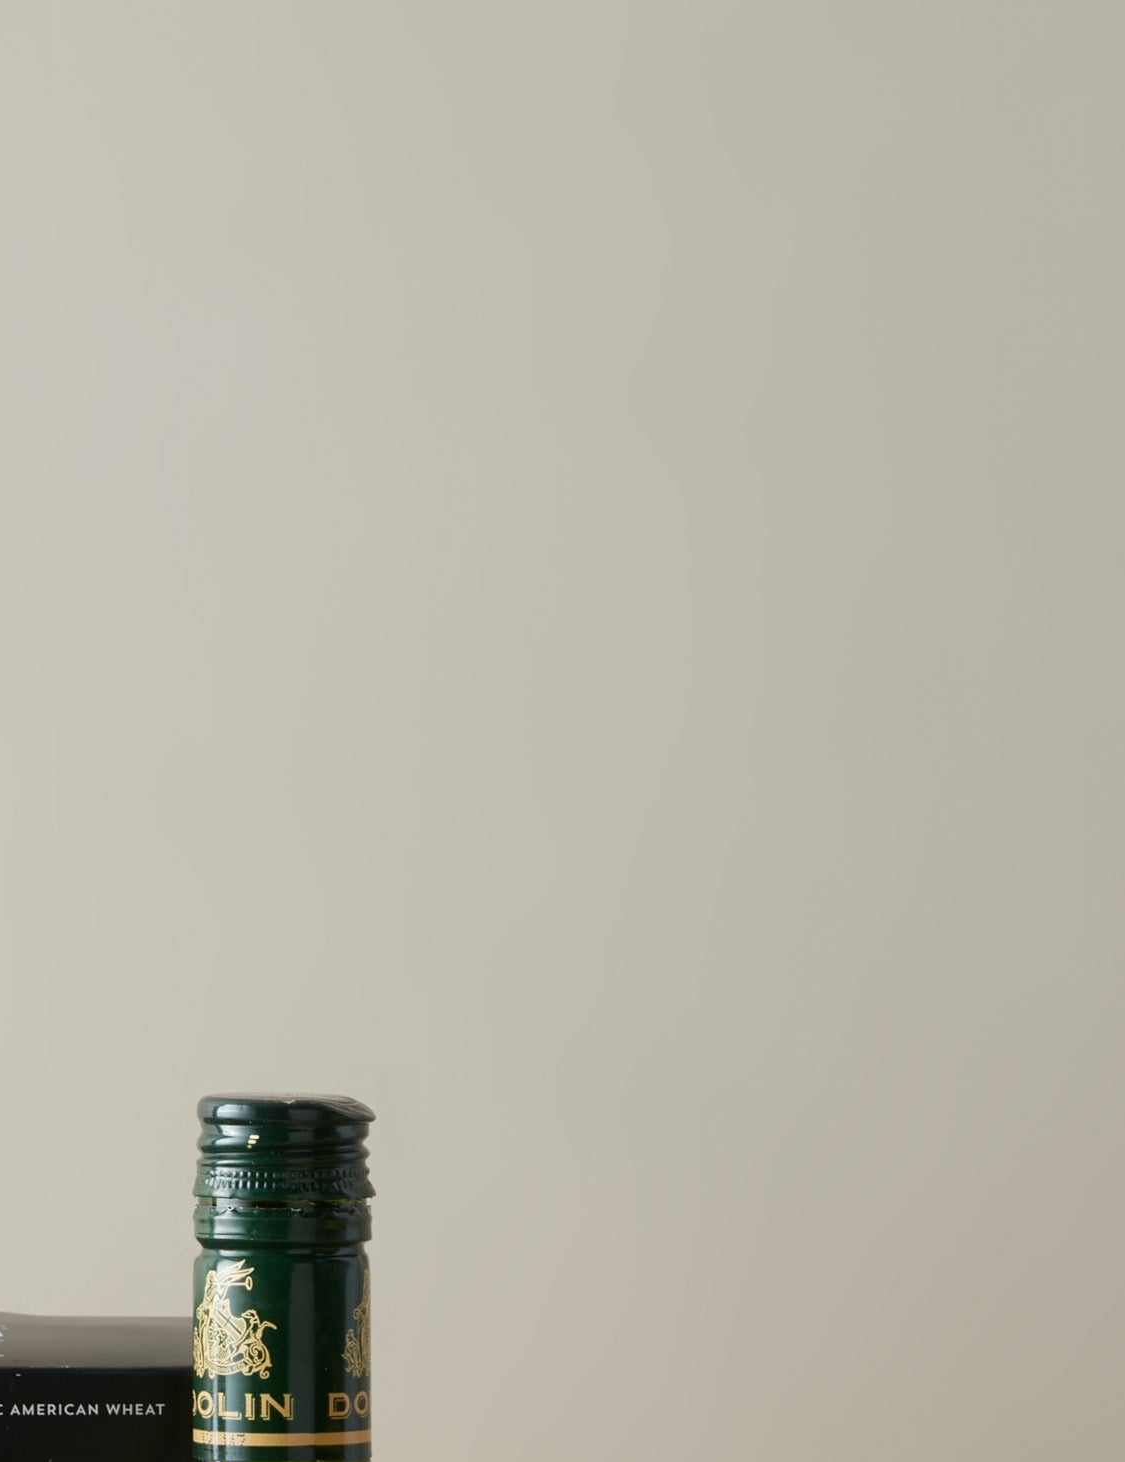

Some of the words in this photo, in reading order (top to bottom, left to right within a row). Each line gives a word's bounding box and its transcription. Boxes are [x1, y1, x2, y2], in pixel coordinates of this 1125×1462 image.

[10, 1403, 99, 1416] AMERICAN
[106, 1403, 166, 1416] WHEAT
[193, 1390, 294, 1420] OLIN
